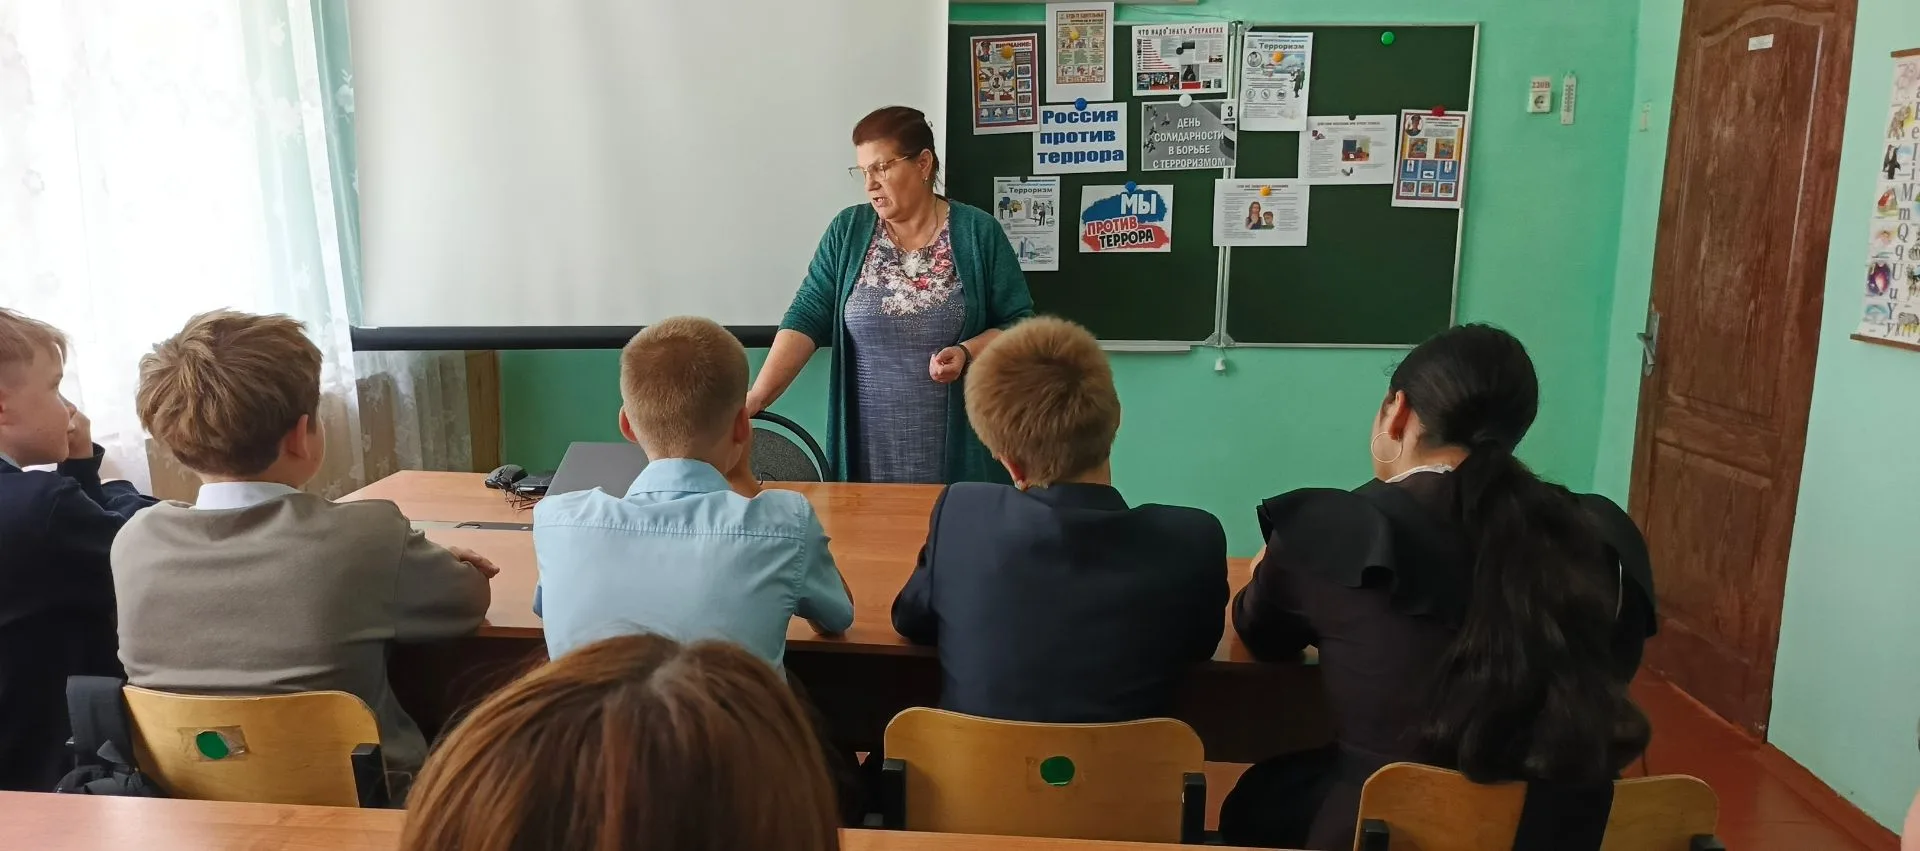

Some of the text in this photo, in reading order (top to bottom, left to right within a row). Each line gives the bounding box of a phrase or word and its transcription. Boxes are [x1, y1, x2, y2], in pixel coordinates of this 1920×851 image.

[1151, 28, 1167, 36] НАДО
[1042, 110, 1118, 124] Россия
[1227, 105, 1233, 117] 3
[1177, 117, 1201, 129] ДЕНЬ
[1040, 130, 1116, 145] против
[1154, 130, 1224, 143] СОЛИДАРНОСТИ
[1912, 126, 1920, 139] e
[1037, 149, 1124, 164] террора
[1168, 145, 1210, 155] В БОРЬБЕ
[1153, 157, 1225, 169] С ТЕРРОРИЗМОМ
[1901, 183, 1914, 201] M
[1121, 193, 1156, 214] МЫ
[1898, 207, 1911, 220] m
[1087, 216, 1137, 236] ПРОТИВ
[1898, 222, 1909, 242] Q
[1099, 229, 1154, 249] ТЕРРОРА
[1895, 245, 1904, 260] q
[1892, 263, 1904, 280] U
[1889, 287, 1898, 299] u
[1887, 302, 1897, 319] Y
